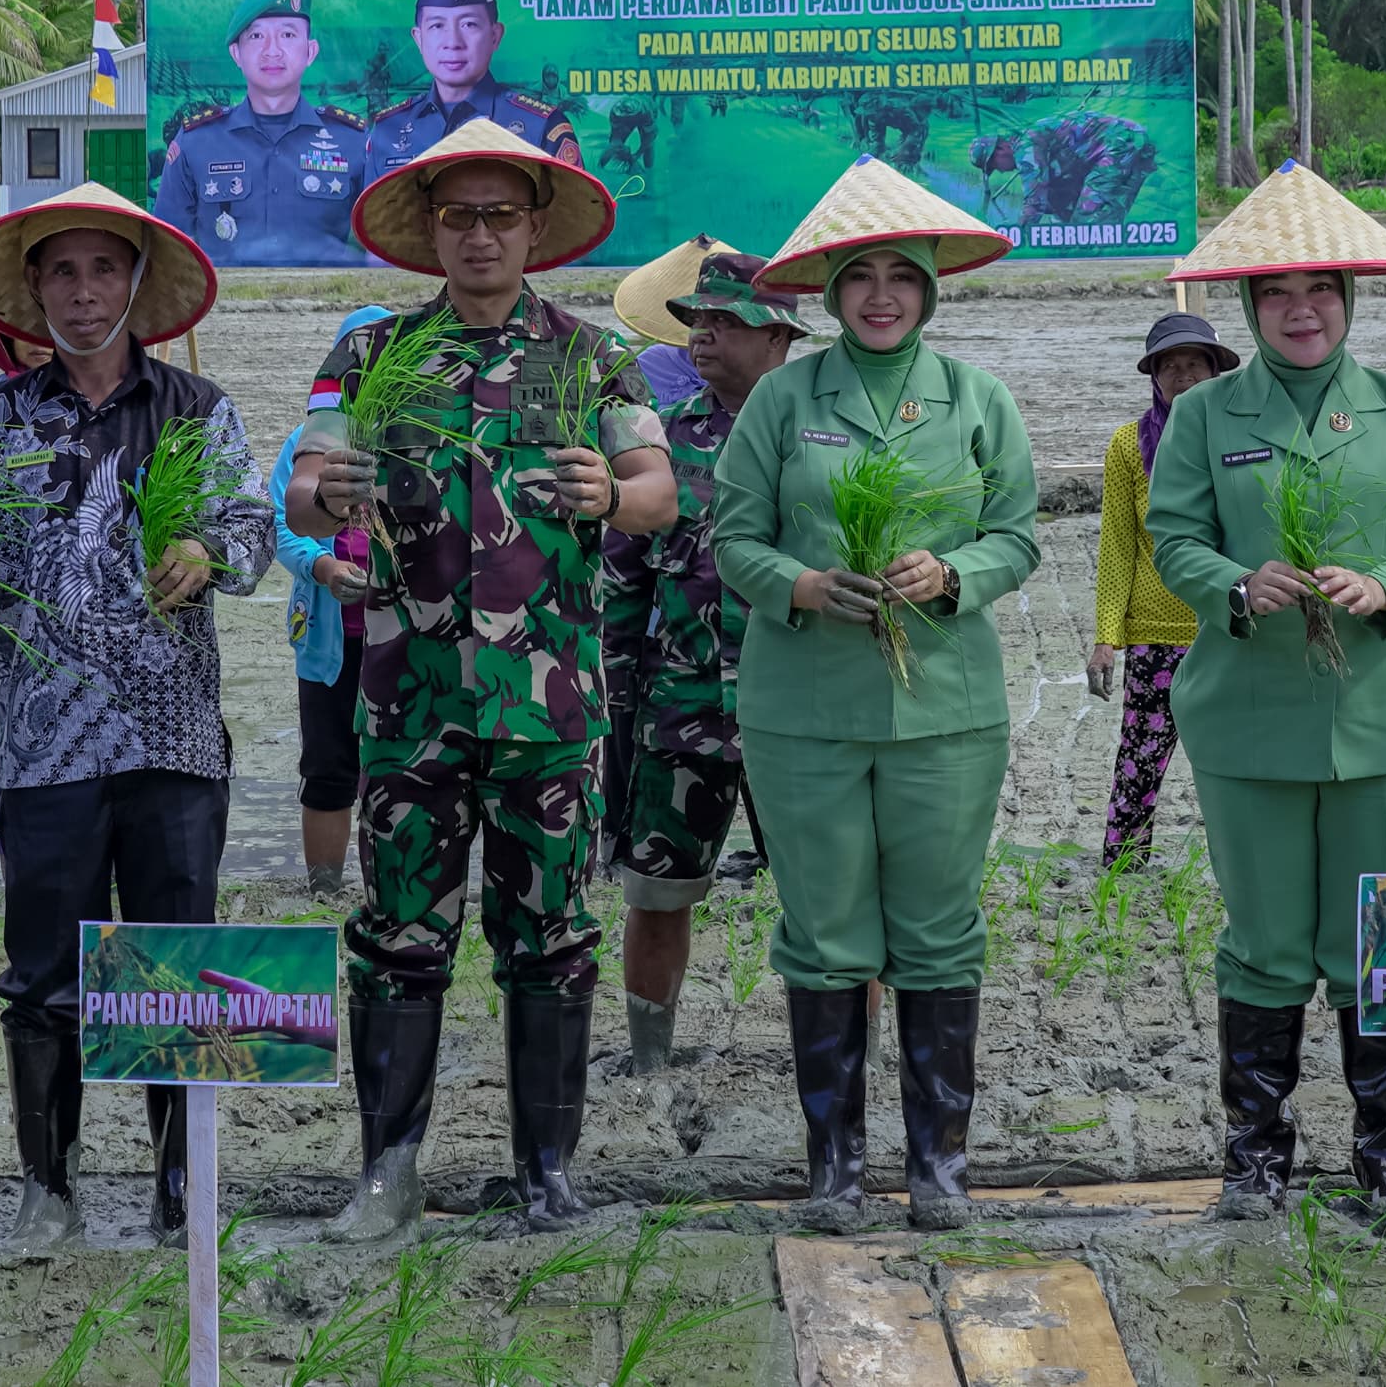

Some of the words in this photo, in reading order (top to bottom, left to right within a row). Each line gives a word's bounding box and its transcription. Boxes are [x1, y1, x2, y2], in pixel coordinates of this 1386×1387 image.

[638, 32, 695, 55] PADA
[700, 31, 768, 54] LAHAN
[774, 29, 871, 53] DEMPLOT
[877, 27, 956, 51] SELUAS
[962, 26, 973, 49] 1
[978, 24, 1060, 48] HEKTAR
[569, 70, 591, 93] DI
[598, 69, 652, 93] DESA
[657, 67, 760, 92] WAIHATU,
[767, 65, 890, 90] KABUPATEN
[896, 63, 969, 88] SERAM
[976, 61, 1056, 85] BAGIAN
[1063, 58, 1132, 83] BARAT
[1031, 225, 1122, 247] FEBRUARI
[1127, 222, 1177, 244] 2025
[519, 386, 553, 402] TNI
[85, 991, 218, 1026] PANGDAM
[226, 993, 332, 1027] XV/PTM
